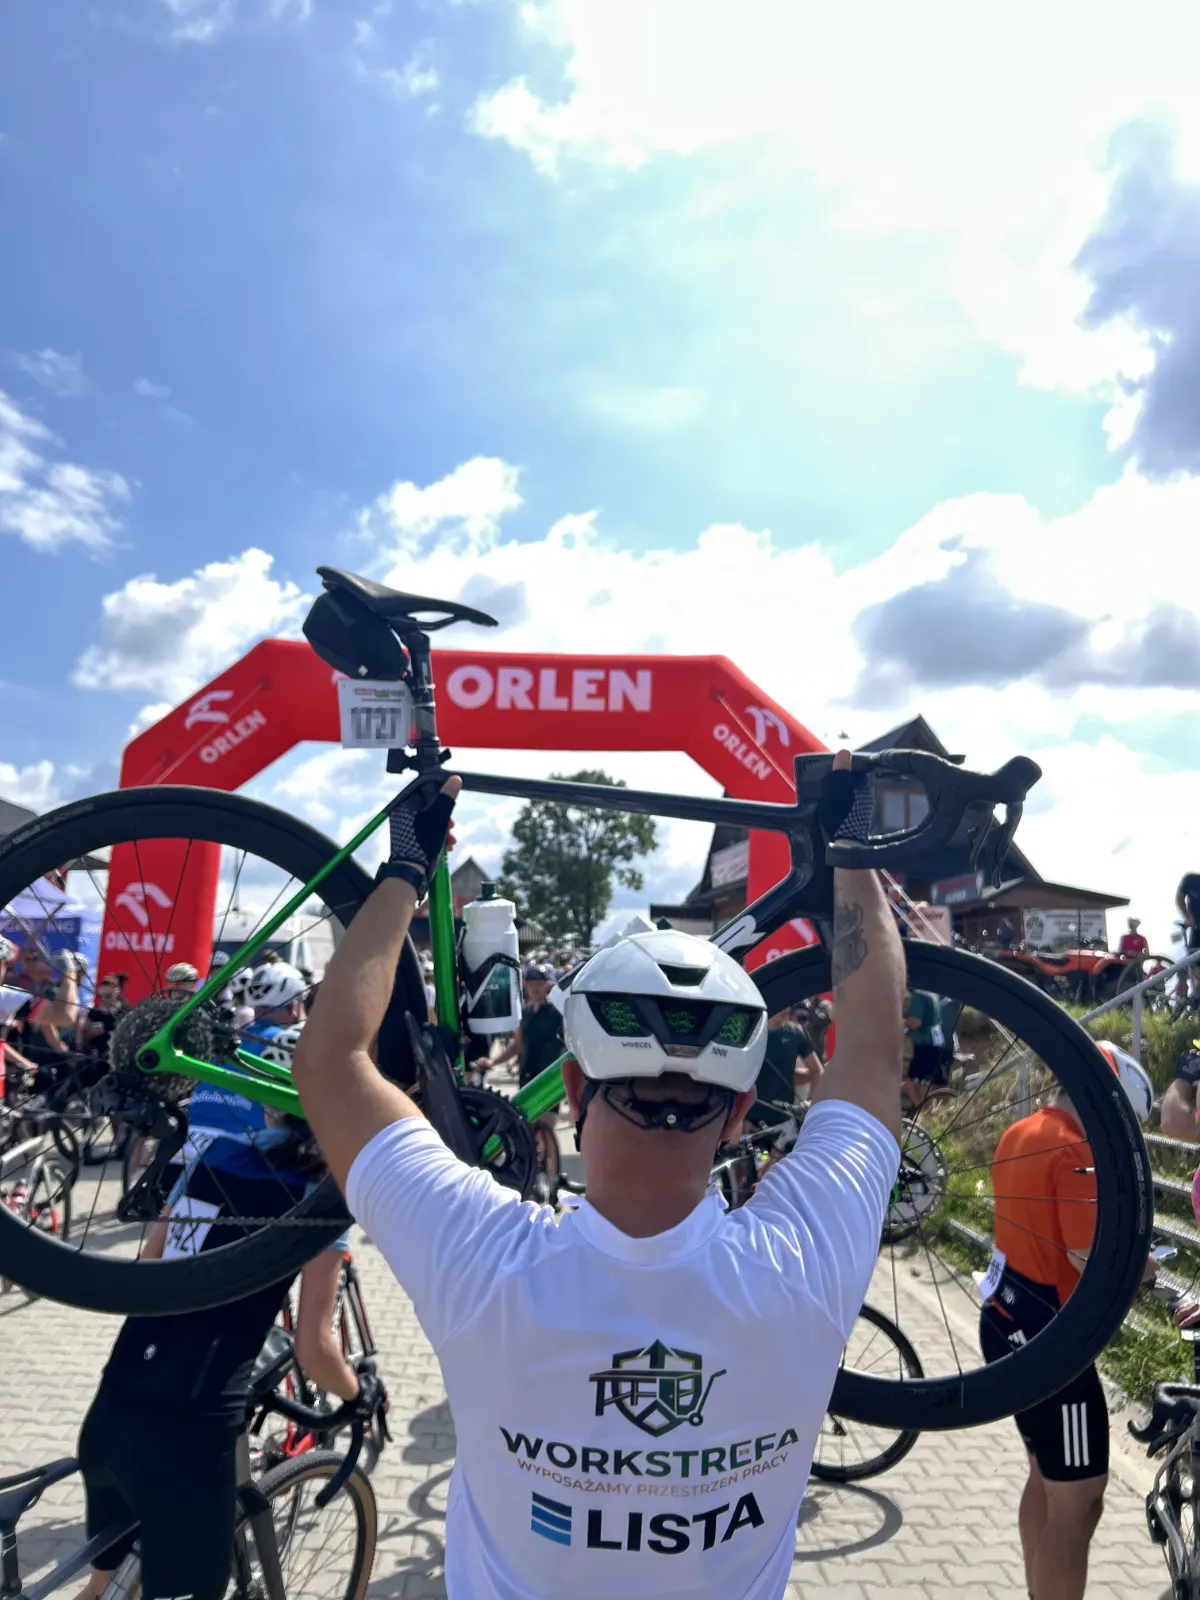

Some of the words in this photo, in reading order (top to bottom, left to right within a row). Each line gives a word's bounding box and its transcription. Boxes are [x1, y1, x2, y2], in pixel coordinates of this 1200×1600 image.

[447, 665, 653, 712] ORLEN
[200, 709, 267, 764] ORLEN
[712, 723, 772, 780] ORLEN
[105, 931, 175, 953] ORLEN
[499, 1426, 799, 1478] WORKSTREFA
[517, 1458, 632, 1495] WYPOSAŻAMY
[743, 1452, 788, 1480] PRACY
[586, 1491, 765, 1554] LISTA
